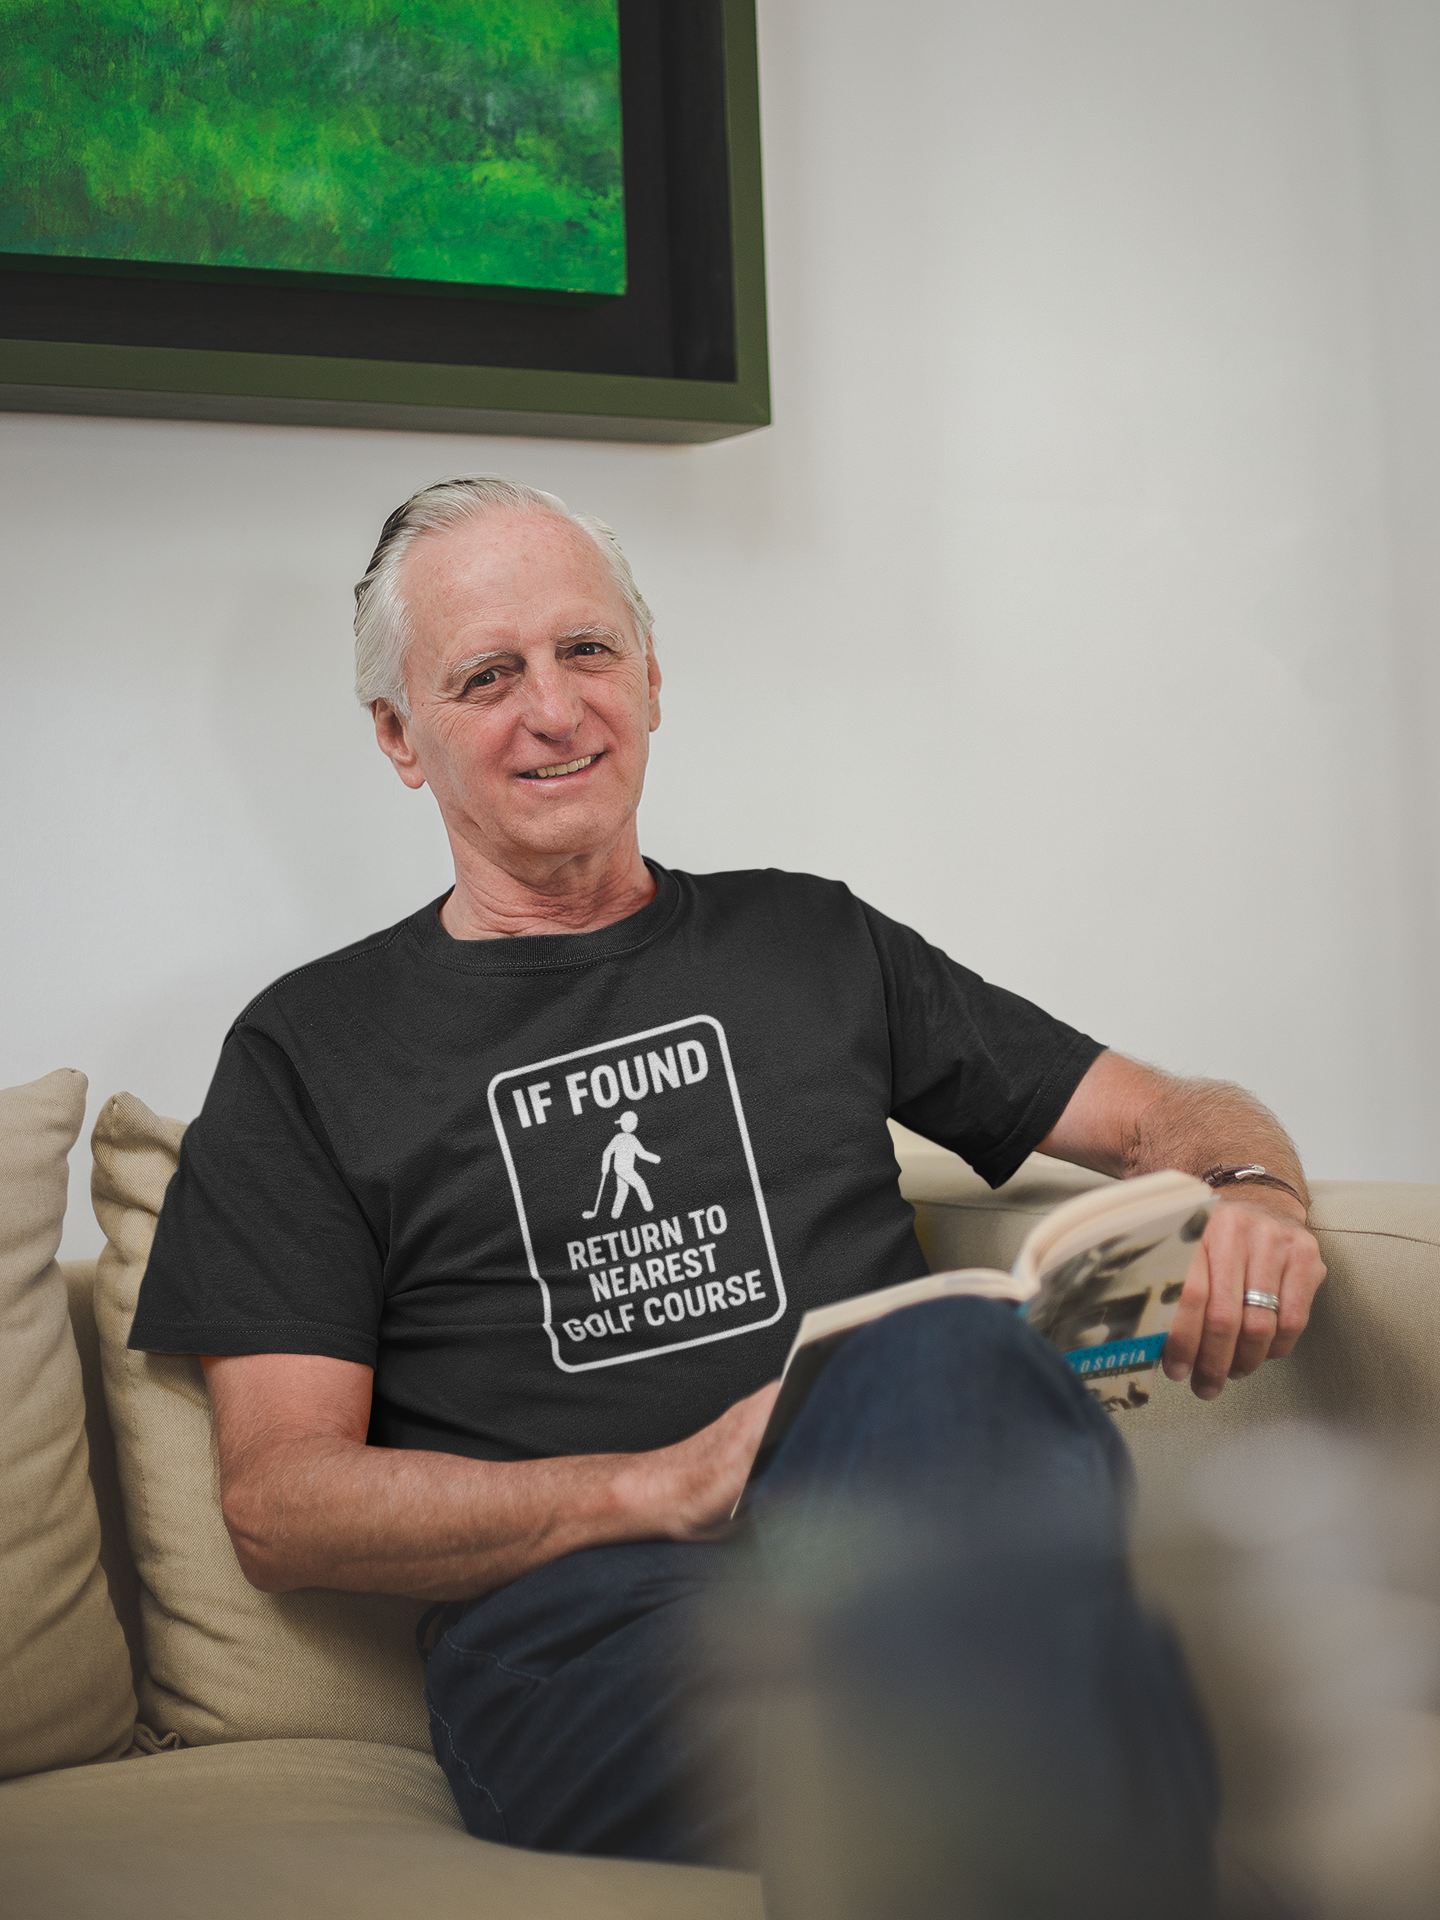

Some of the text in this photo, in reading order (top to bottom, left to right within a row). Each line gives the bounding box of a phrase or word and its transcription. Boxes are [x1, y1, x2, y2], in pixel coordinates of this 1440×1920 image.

[512, 1039, 709, 1129] IF FOUND
[566, 1204, 728, 1271] RETURN TO
[562, 1268, 767, 1342] GOLF COURSE
[588, 1242, 717, 1303] NEAREST
[1071, 1348, 1146, 1374] OSOFÍA
